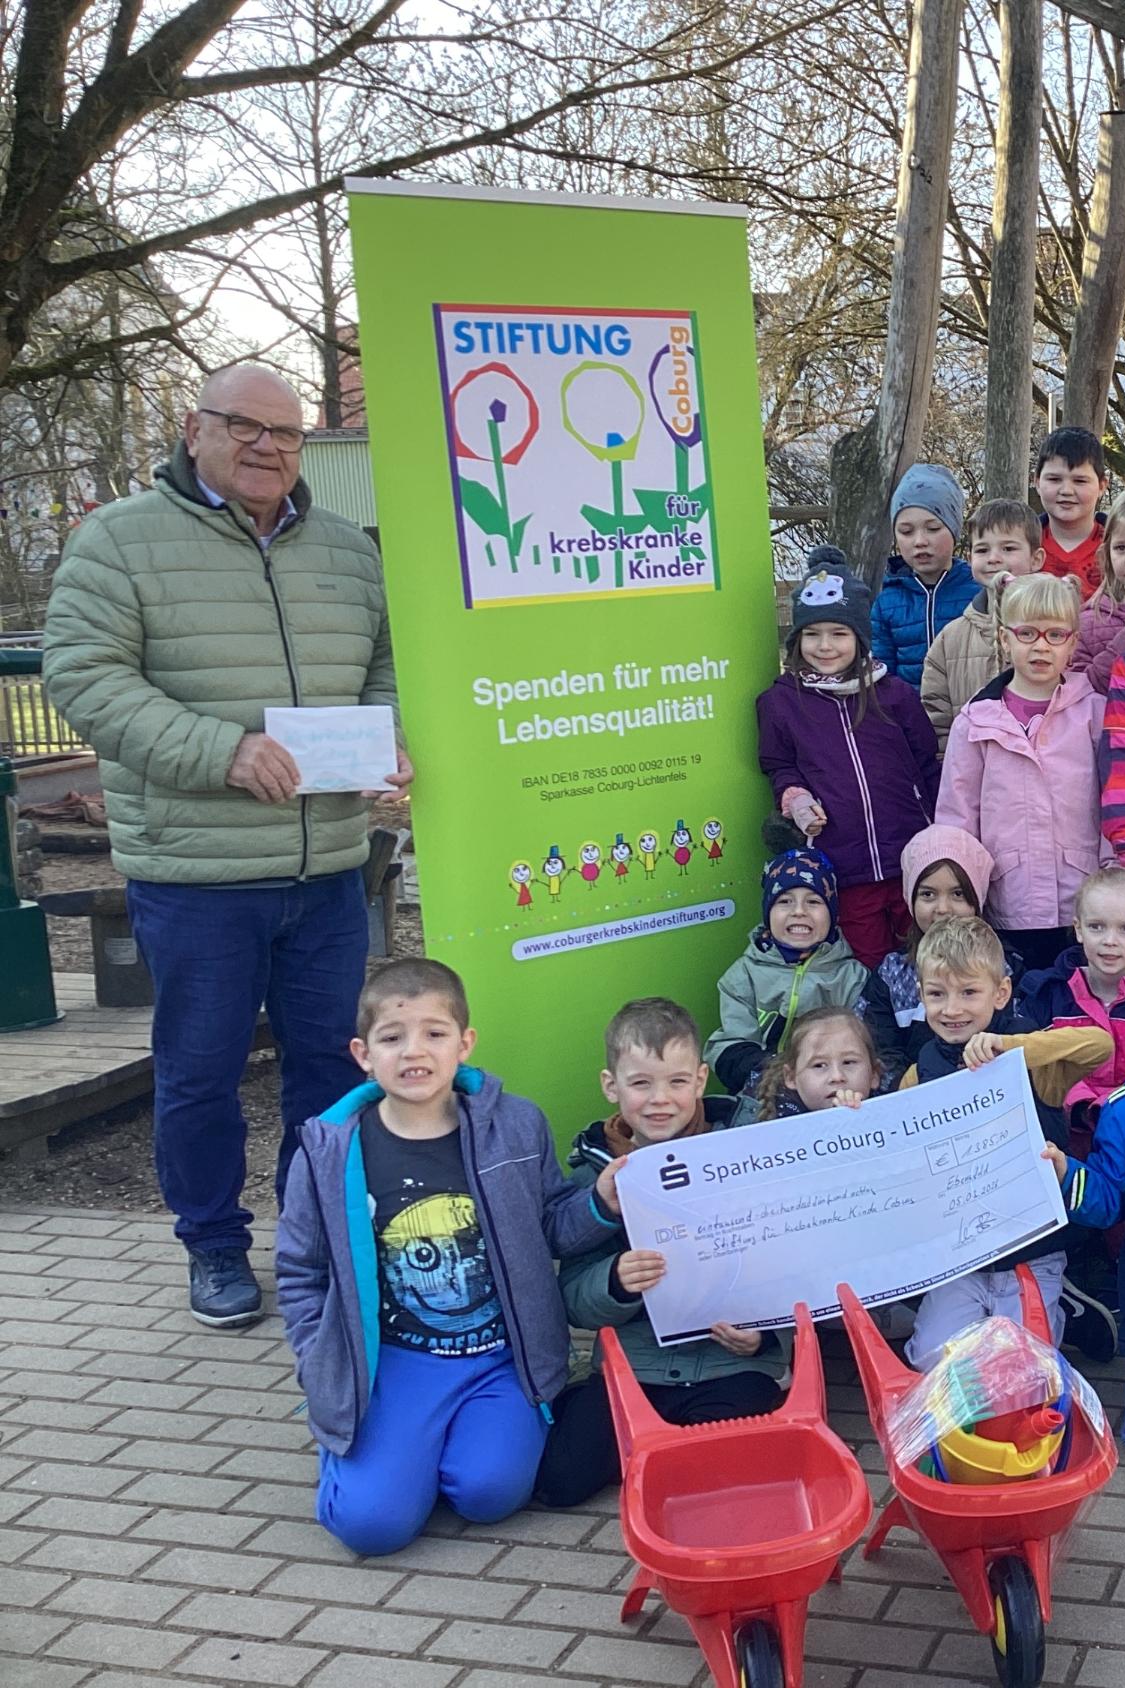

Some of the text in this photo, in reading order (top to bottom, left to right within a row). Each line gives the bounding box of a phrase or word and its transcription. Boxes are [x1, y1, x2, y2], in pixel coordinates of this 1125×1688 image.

[453, 320, 632, 356] STIFTUNG
[668, 325, 690, 434] Coburg
[666, 495, 700, 518] für
[549, 526, 703, 554] krebskranke
[629, 556, 706, 580] Kinder
[472, 656, 730, 710] Spenden für mehr
[497, 694, 715, 745] Lebensqualität!
[521, 753, 702, 789] IBAN DE18 7835 0000 0092 0115 19
[540, 771, 687, 802] Sparkasse Coburg-Lichtenfels
[523, 904, 726, 954] www.coburgerkrebskinderstiftung.org
[703, 1147, 807, 1183] Sparkasse
[813, 1131, 885, 1157] Coburg
[902, 1087, 1005, 1137] Lichtenfels
[654, 1223, 688, 1245] DE
